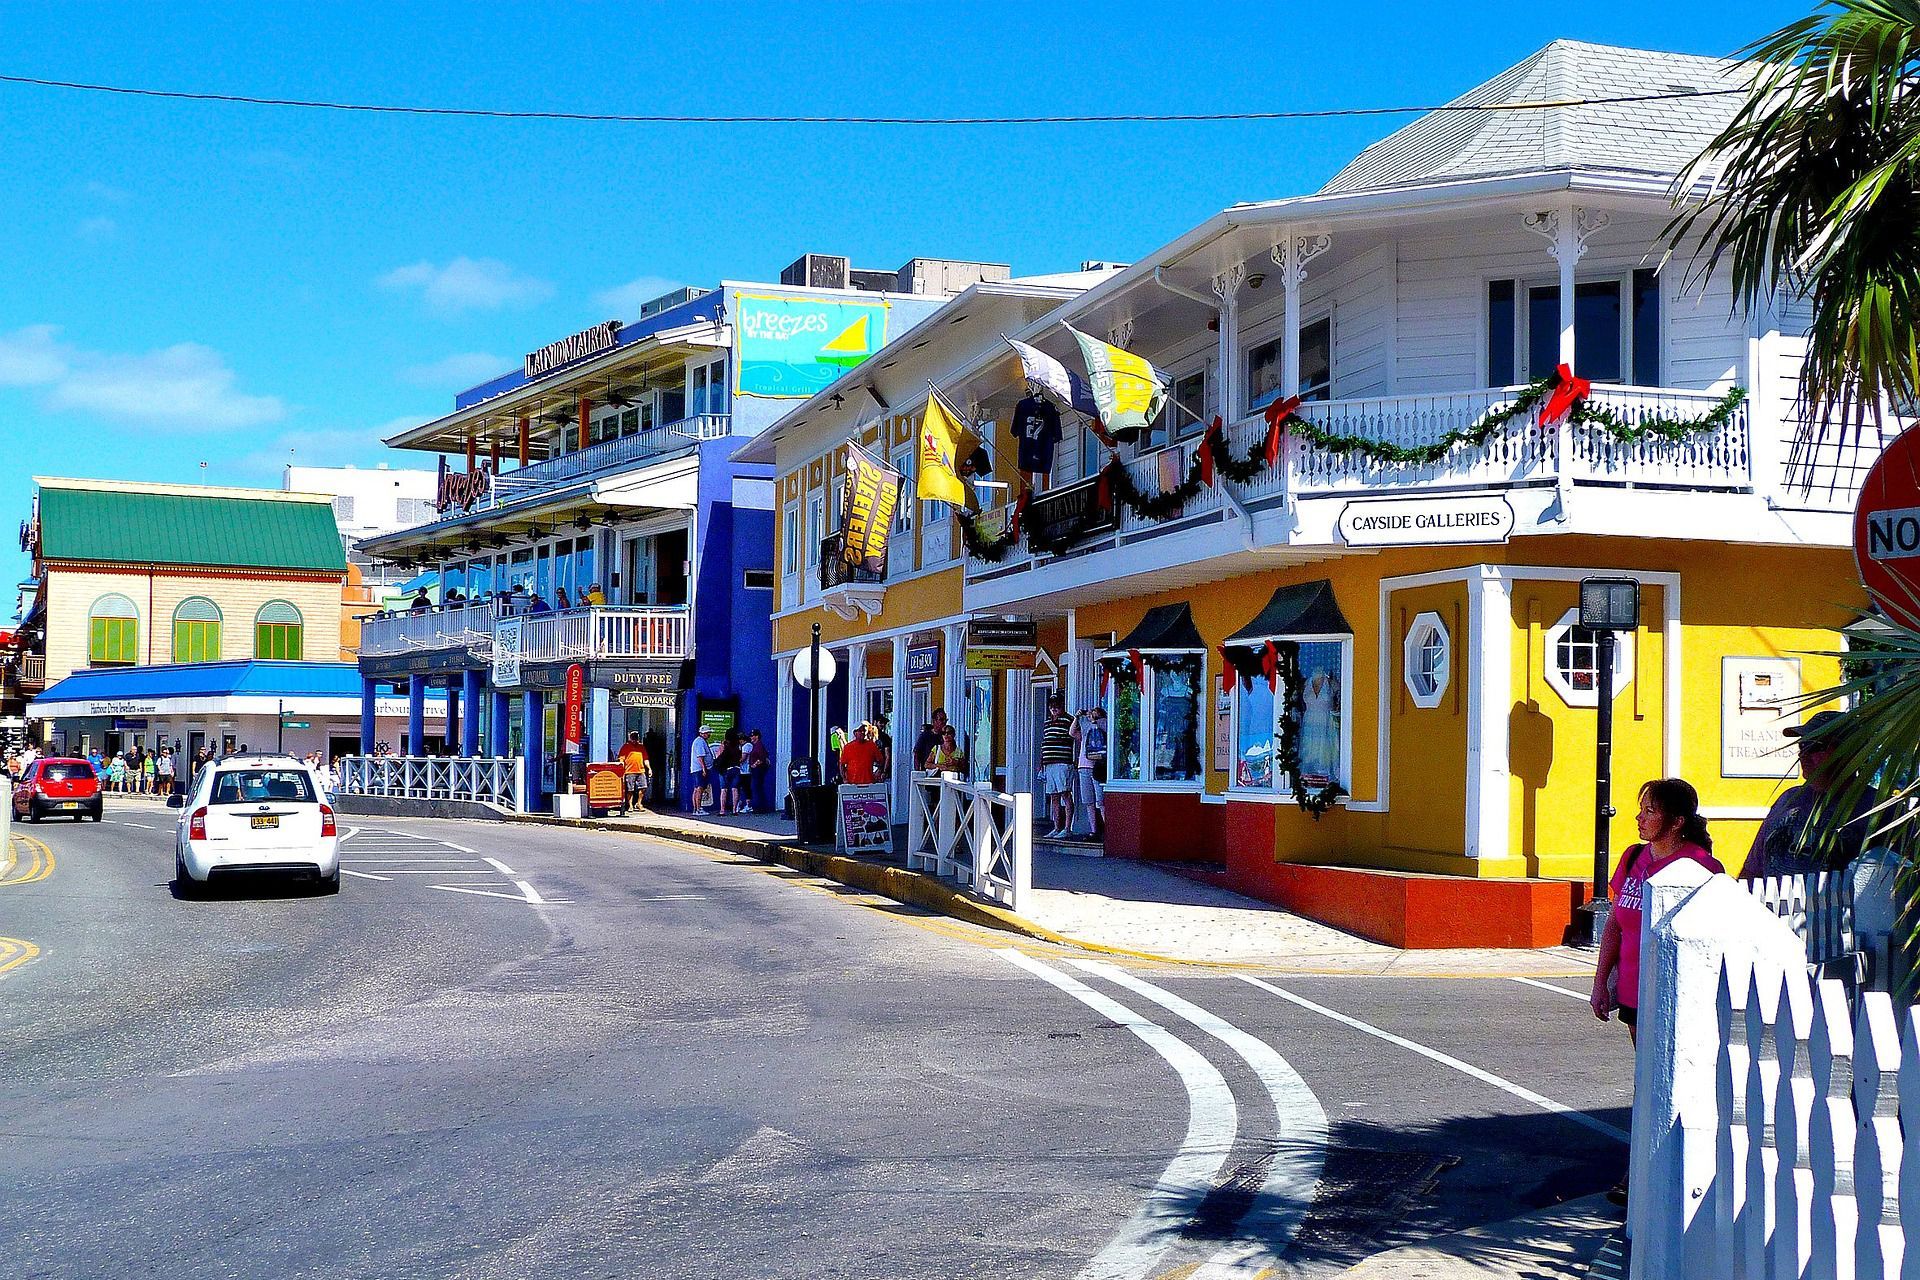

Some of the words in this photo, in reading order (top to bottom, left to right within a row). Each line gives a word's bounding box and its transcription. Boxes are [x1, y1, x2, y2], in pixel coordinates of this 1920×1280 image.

[742, 308, 828, 337] breezes
[524, 320, 615, 379] LANDMARK
[755, 383, 788, 393] Tropical
[791, 384, 811, 393] Grill
[1352, 516, 1412, 531] CAYSIDE
[1415, 511, 1500, 529] GALLERIES
[1870, 517, 1920, 553] NO
[571, 669, 580, 701] CUBAN
[614, 673, 643, 683] DUTY
[645, 674, 673, 684] FREE
[625, 694, 676, 705] LANDMARK
[375, 702, 410, 714] arbou
[425, 706, 446, 714] rive
[569, 704, 579, 738] CIGARS
[1741, 729, 1783, 742] ISLAND
[1728, 746, 1797, 759] TREASURES
